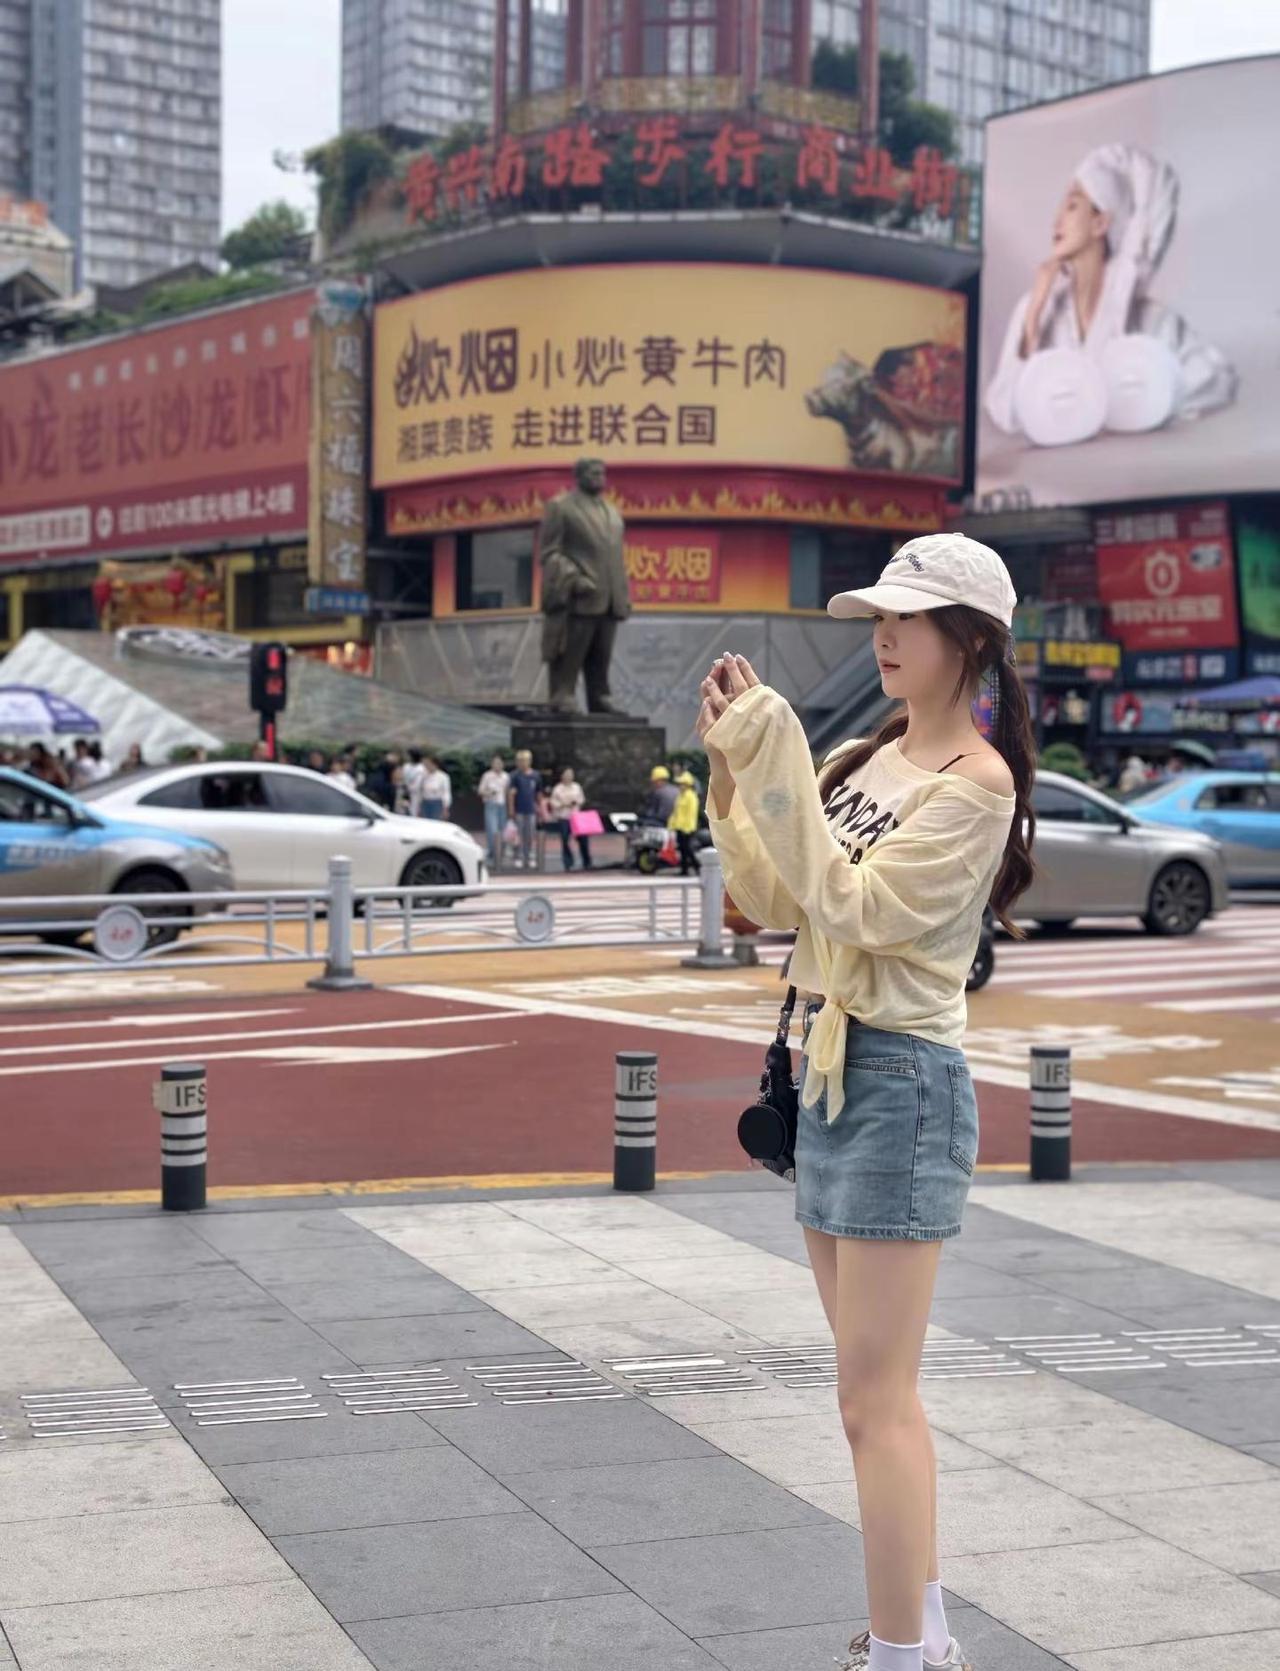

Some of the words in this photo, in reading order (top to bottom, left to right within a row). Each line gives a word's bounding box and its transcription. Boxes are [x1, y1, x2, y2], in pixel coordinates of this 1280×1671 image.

[401, 115, 957, 224] 黄兴南路步行商业街
[511, 404, 716, 448] 走进联合国
[823, 783, 902, 849] UNDA
[175, 1082, 207, 1108] IFS
[629, 1070, 657, 1091] IFS
